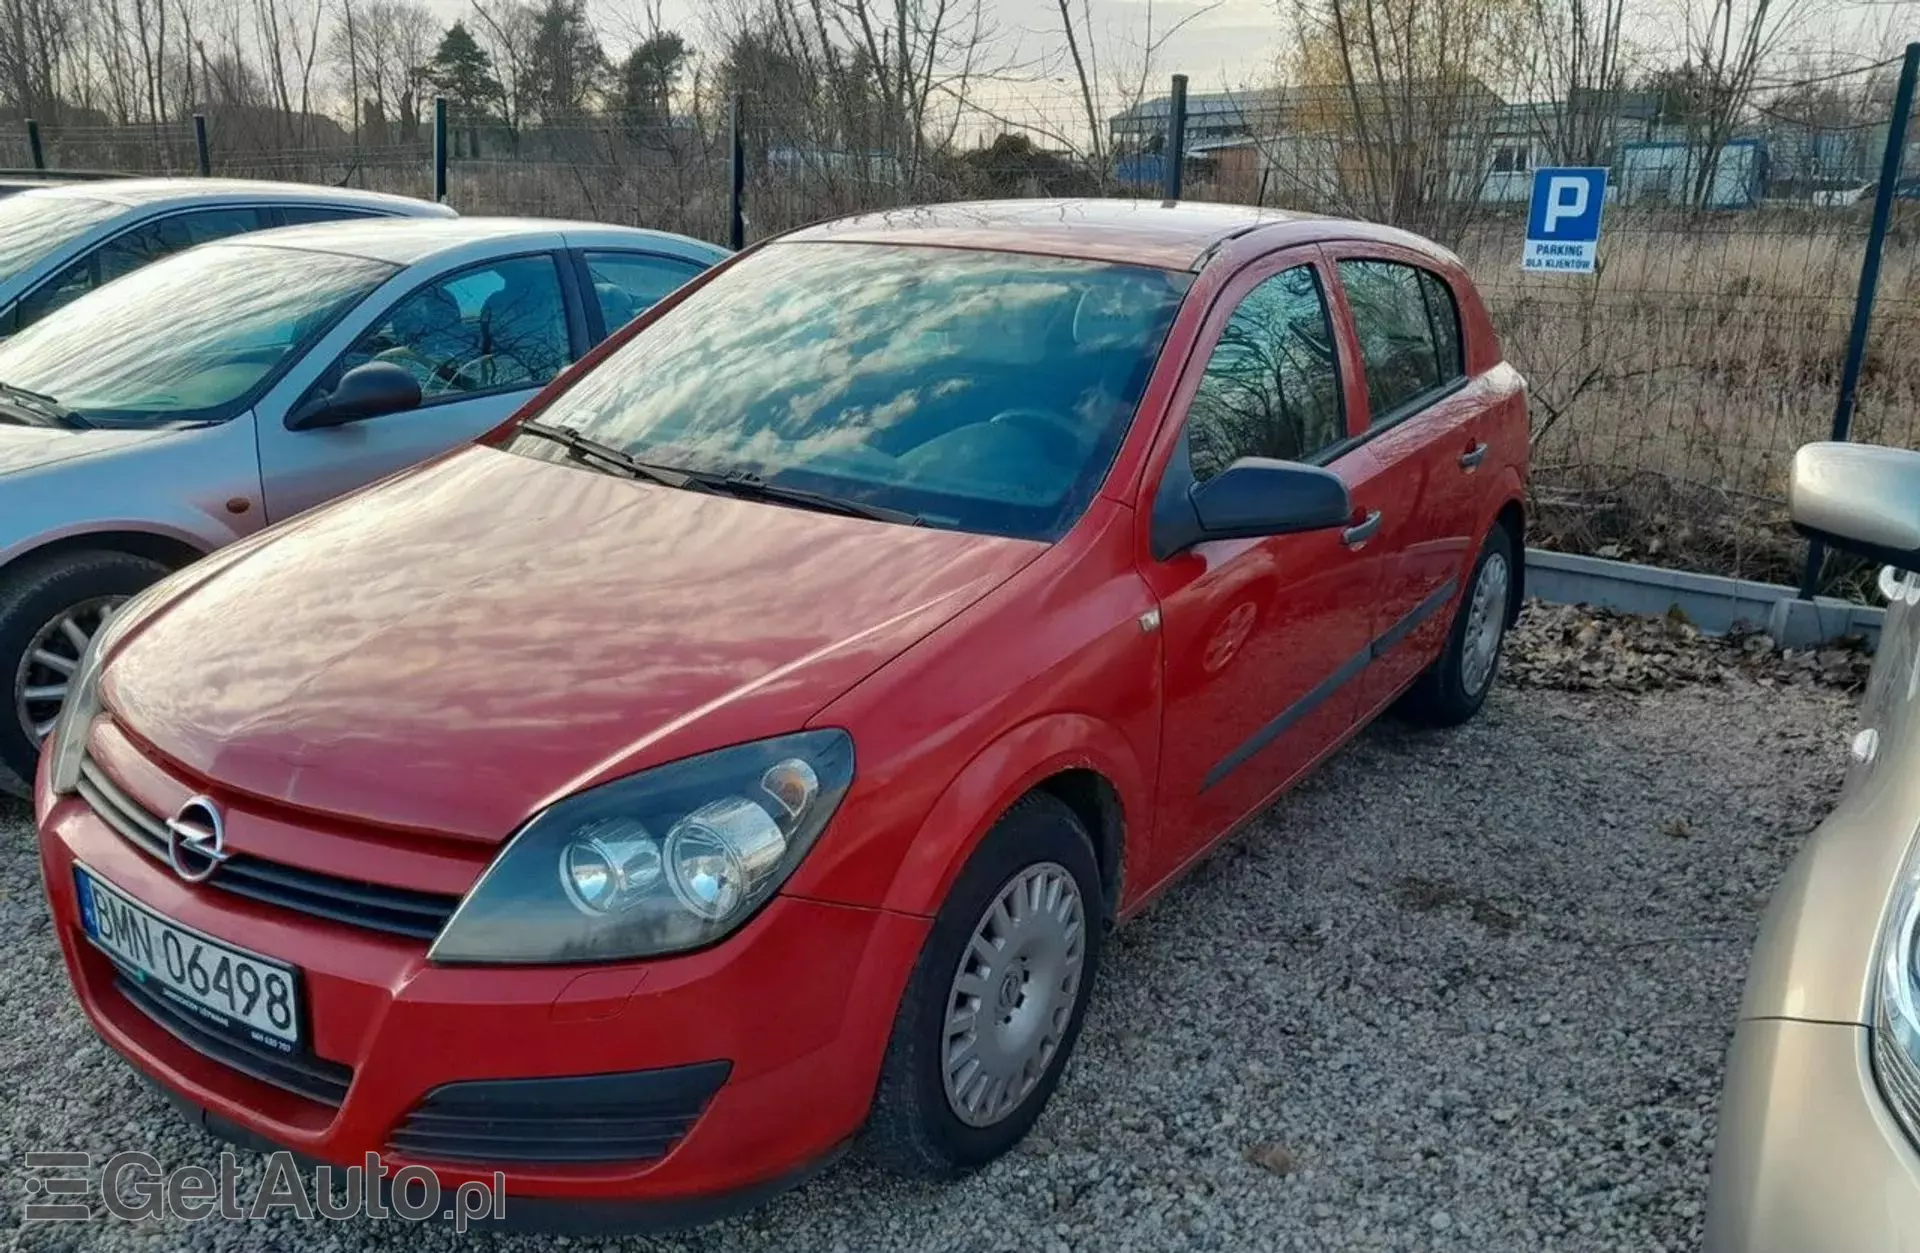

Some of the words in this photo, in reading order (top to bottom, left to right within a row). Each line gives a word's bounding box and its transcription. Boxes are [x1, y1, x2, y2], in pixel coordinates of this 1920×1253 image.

[1544, 176, 1590, 233] P
[1536, 244, 1583, 256] PARKING
[92, 884, 156, 970] BMN
[162, 930, 291, 1030] 06498
